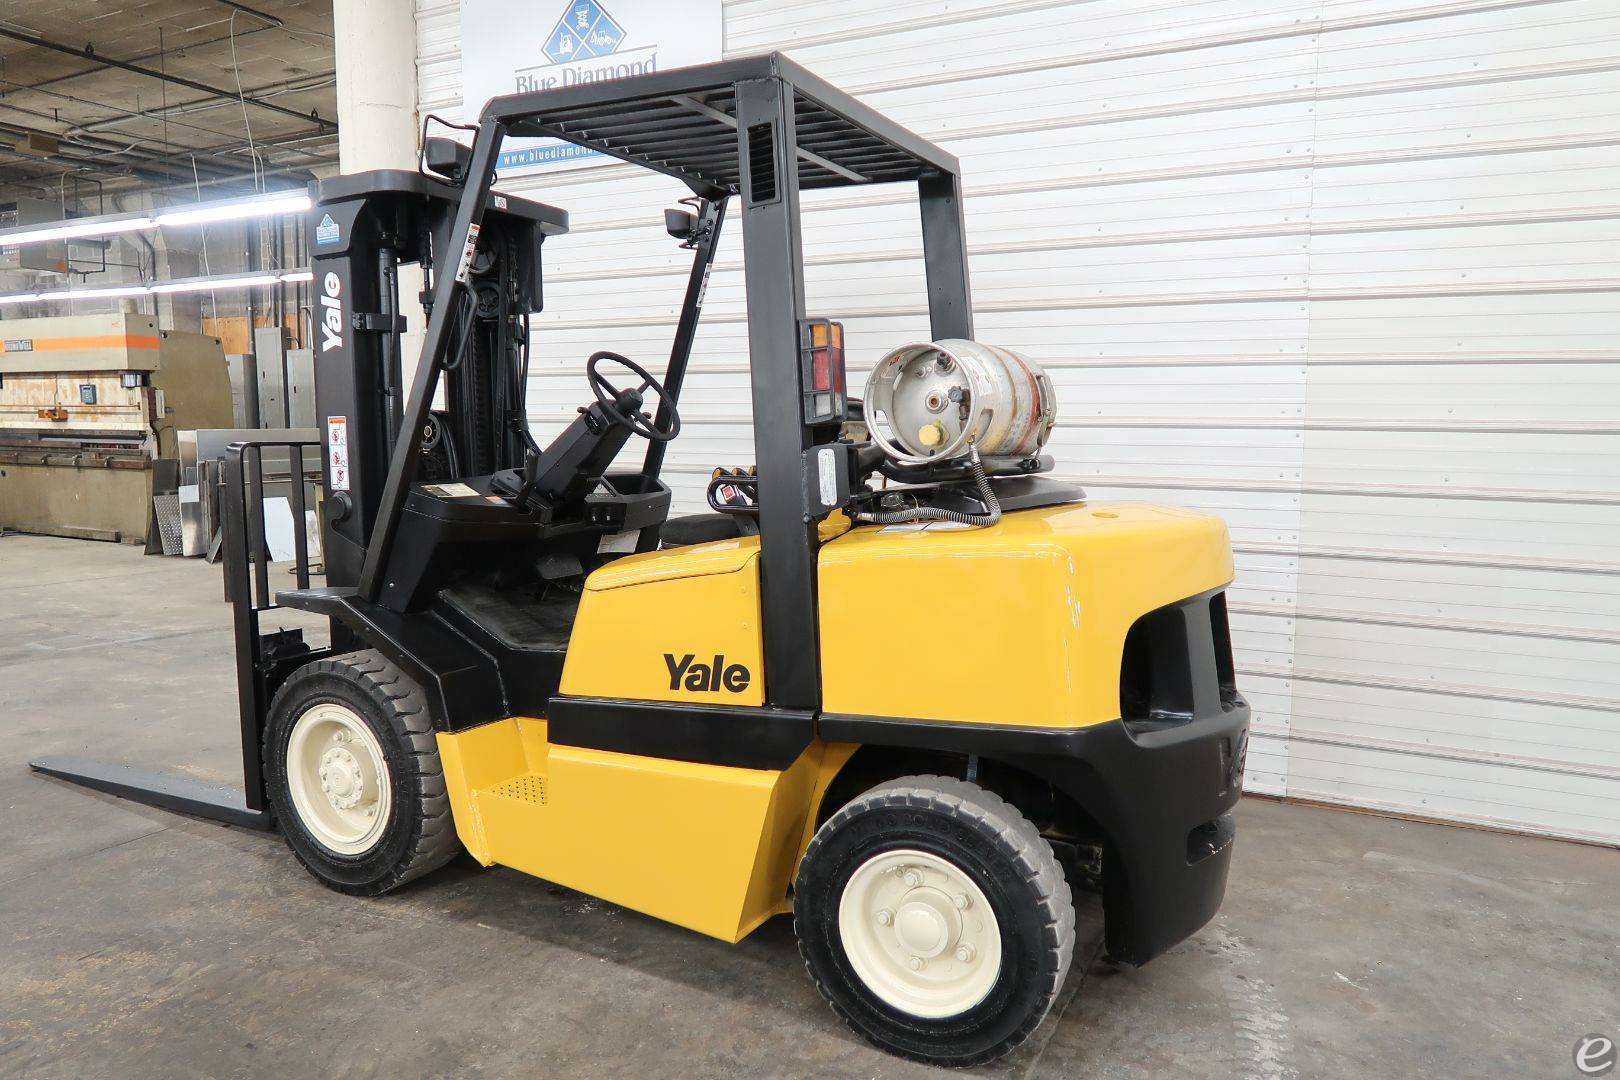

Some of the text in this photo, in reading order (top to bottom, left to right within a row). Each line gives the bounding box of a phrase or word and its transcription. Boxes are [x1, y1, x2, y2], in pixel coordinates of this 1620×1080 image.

[514, 52, 658, 94] Blue Diamond
[320, 271, 342, 353] Yale
[663, 653, 751, 693] Yale
